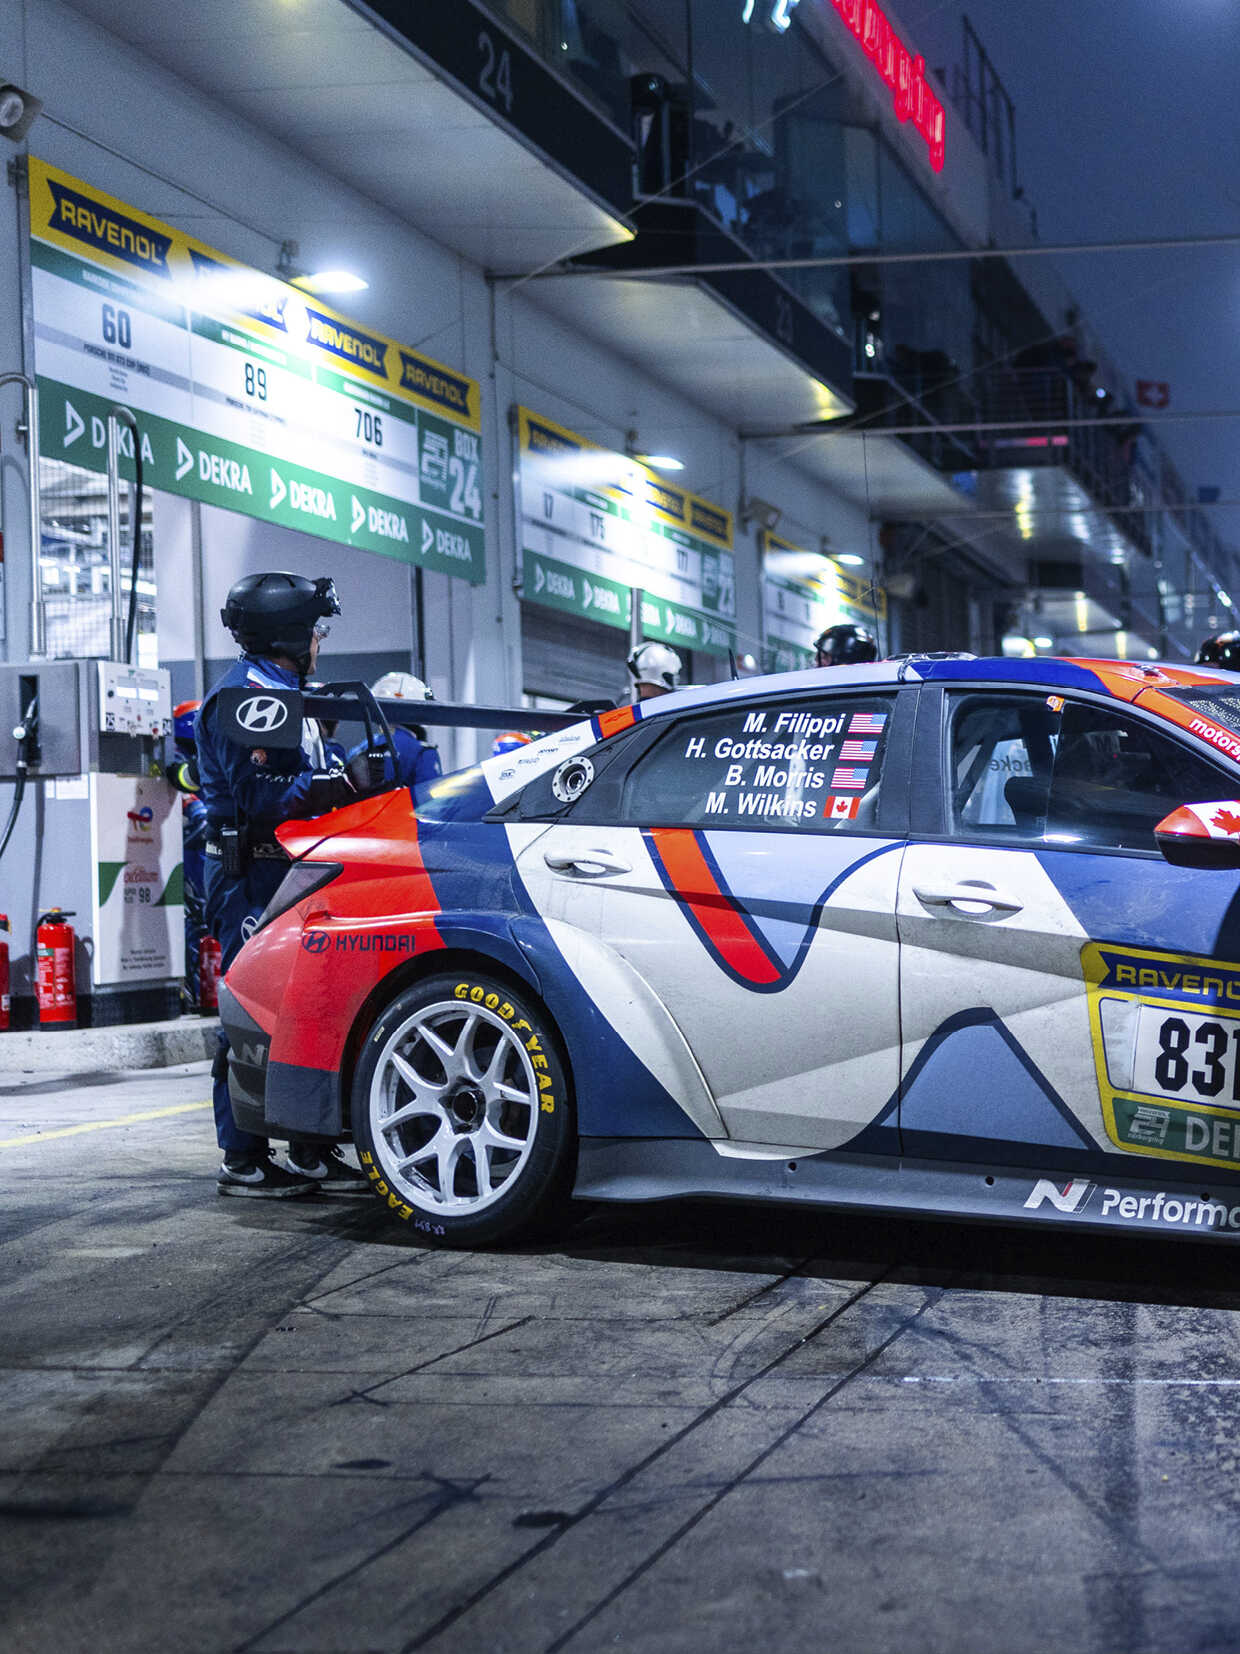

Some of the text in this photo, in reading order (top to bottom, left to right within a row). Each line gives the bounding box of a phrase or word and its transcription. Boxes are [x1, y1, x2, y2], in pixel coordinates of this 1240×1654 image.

[478, 32, 511, 113] 24
[60, 198, 163, 266] RAVENOL
[102, 303, 132, 349] 60
[310, 317, 382, 367] RAVENOL
[245, 362, 267, 401] 89
[405, 363, 465, 406] RAVENOL
[92, 416, 154, 465] DKA
[354, 407, 383, 447] 706
[453, 428, 480, 463] BOX
[199, 450, 253, 495] DEKRA
[450, 457, 482, 520] 24
[289, 480, 337, 521] DEKRA
[368, 506, 410, 543] DEKRA
[436, 529, 473, 562] DEKRA
[742, 713, 846, 738] M. Filippi
[685, 738, 835, 760] H. Gottsacker
[724, 765, 825, 788] B. Morris
[705, 792, 817, 817] M. Wilkins
[138, 887, 151, 904] 98
[336, 935, 416, 952] HYUNDAI
[454, 982, 556, 1115] GOODYEAR
[359, 1149, 415, 1221] EAGLE
